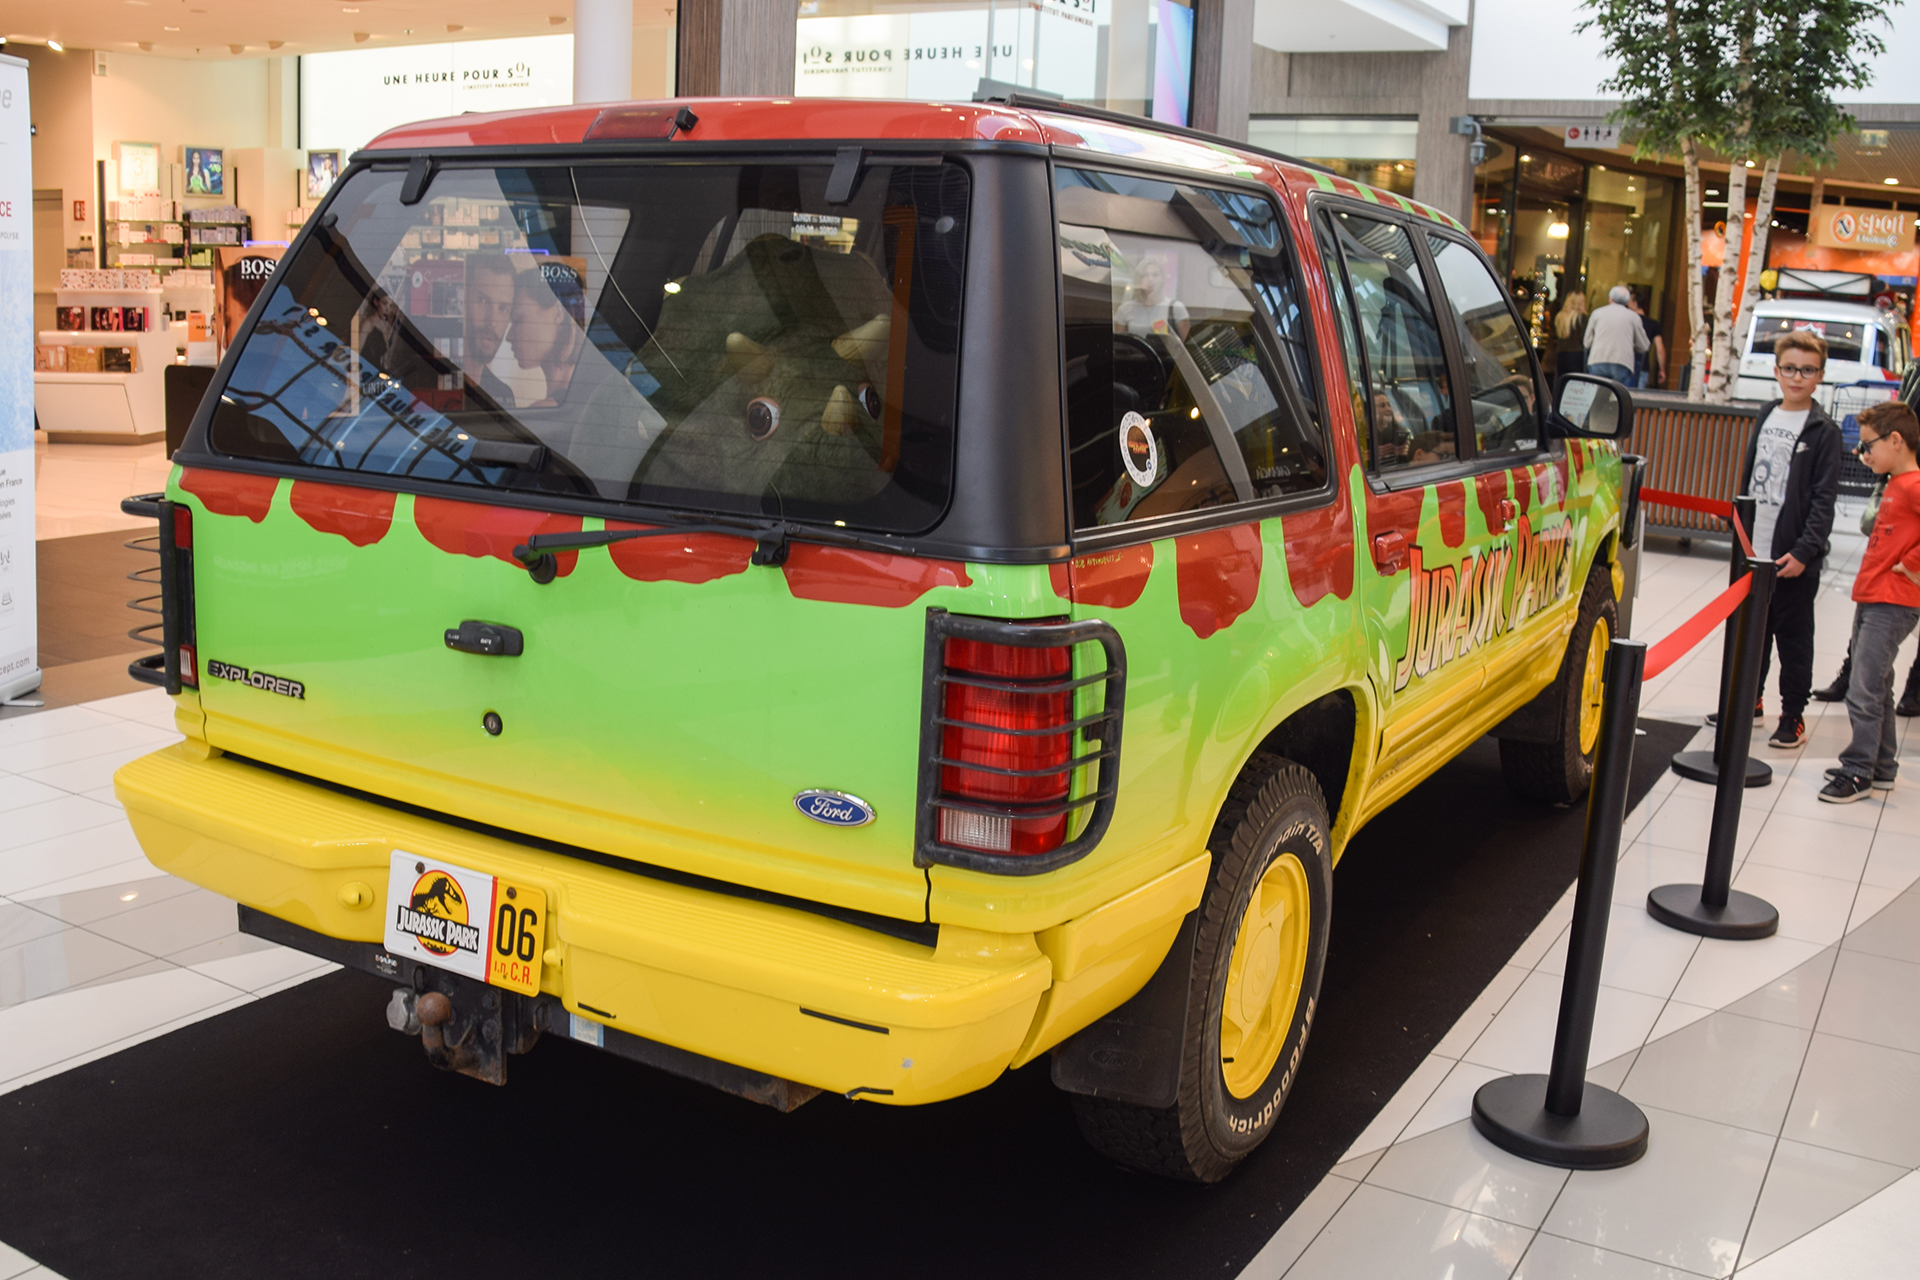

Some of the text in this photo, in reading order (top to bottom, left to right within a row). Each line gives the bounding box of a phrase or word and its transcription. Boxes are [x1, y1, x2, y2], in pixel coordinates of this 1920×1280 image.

[383, 62, 531, 85] UNE HEURE POUR SOI
[1858, 213, 1907, 236] sport
[540, 265, 578, 279] BOSS
[1394, 512, 1572, 693] JURASSIC PARK
[209, 661, 303, 699] EXPLORER
[810, 796, 854, 821] Ford
[397, 906, 479, 951] JURASSIC PARK
[496, 903, 538, 963] 06
[1229, 996, 1315, 1135] BFGoodrich
